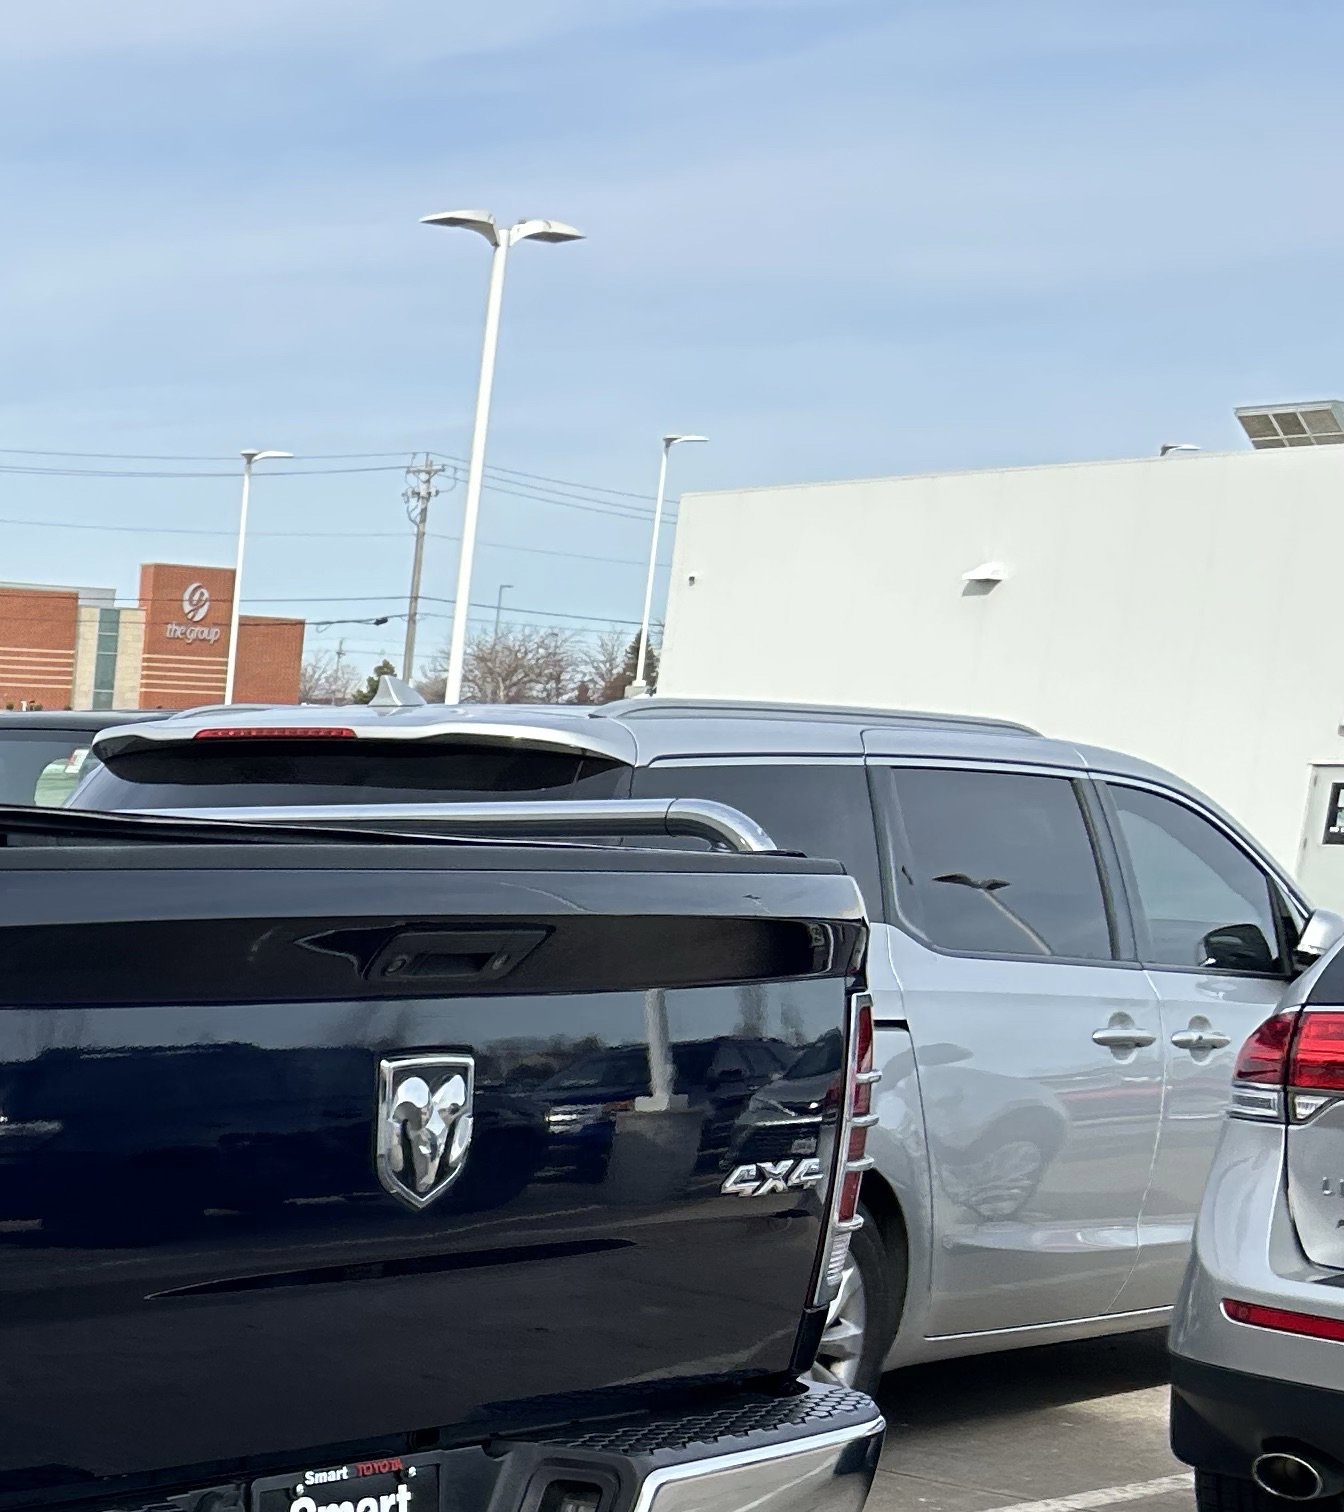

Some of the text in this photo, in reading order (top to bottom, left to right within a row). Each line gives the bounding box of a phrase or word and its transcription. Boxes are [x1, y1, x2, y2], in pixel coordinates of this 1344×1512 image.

[166, 623, 221, 645] the group
[304, 1457, 404, 1486] Smart TOYOTA
